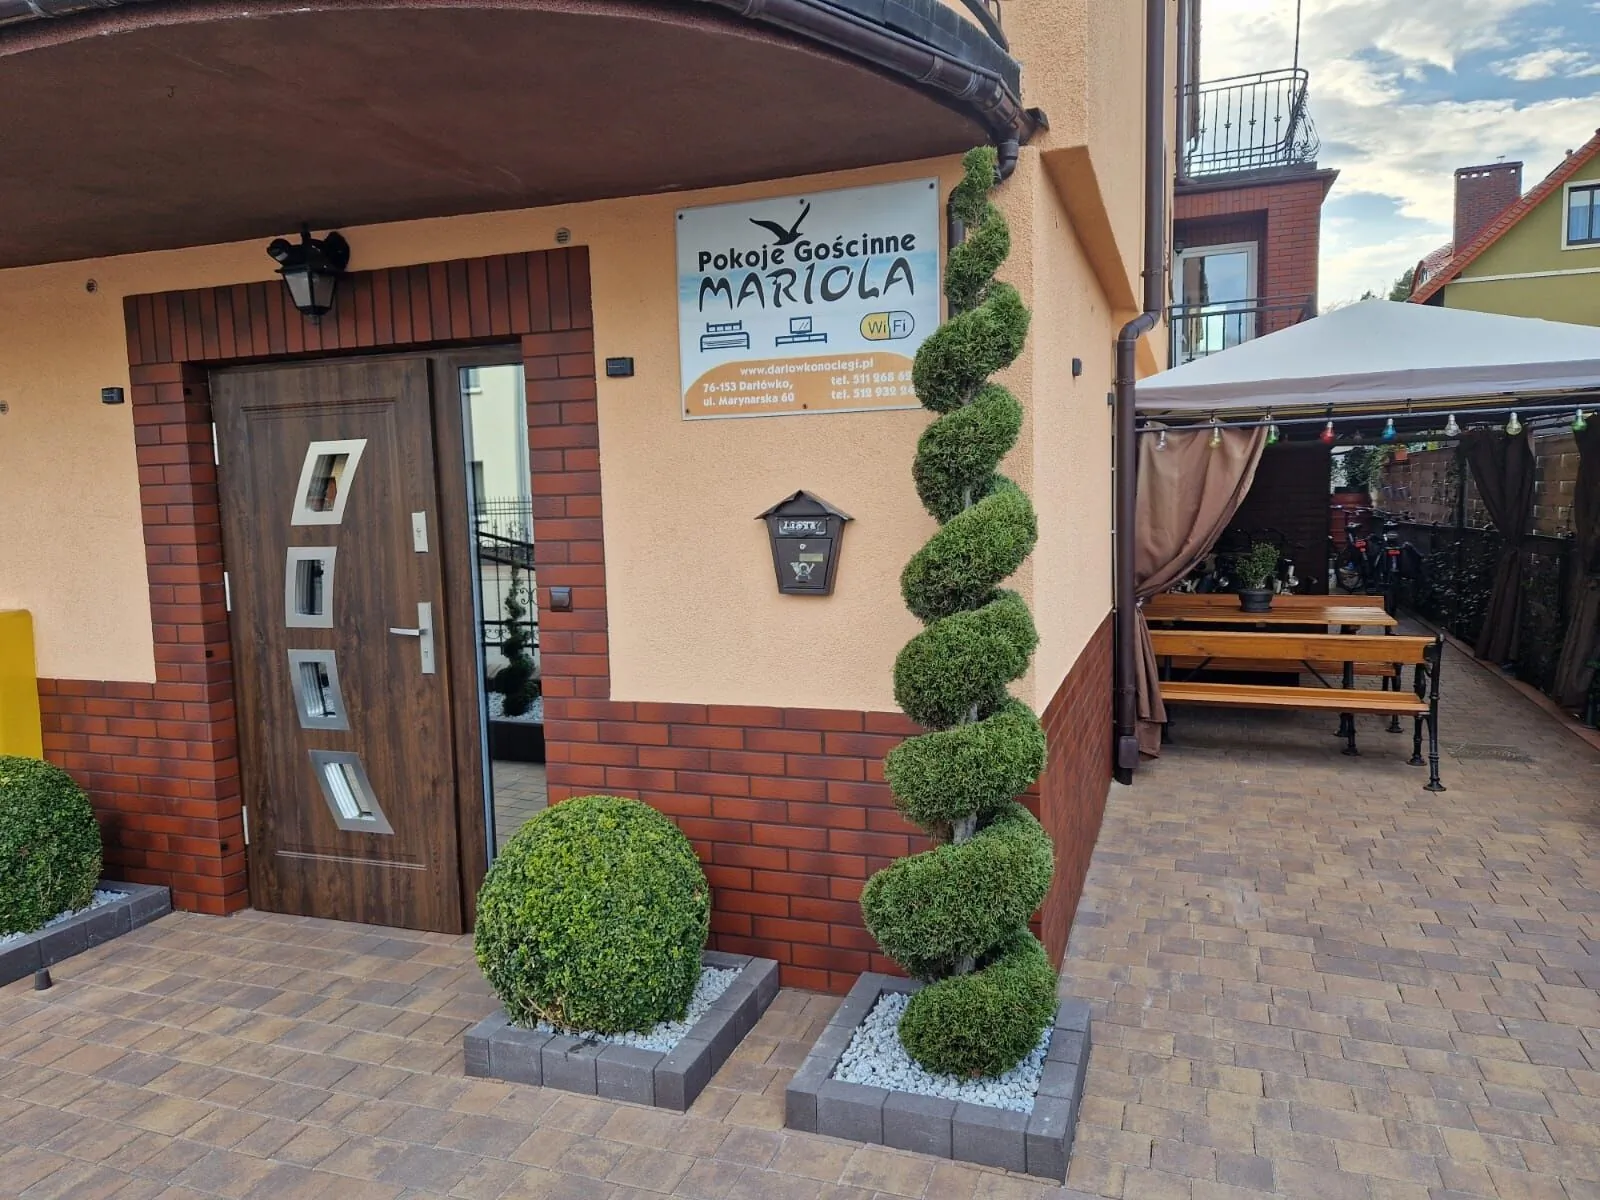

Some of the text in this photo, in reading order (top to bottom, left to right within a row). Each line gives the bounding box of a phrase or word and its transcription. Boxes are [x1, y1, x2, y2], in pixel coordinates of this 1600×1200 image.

[699, 233, 916, 272] Pokoje Gościnne
[699, 257, 914, 312] MARIOLA
[740, 357, 874, 376] www.darlowkonoclegi.pl
[703, 382, 737, 393] 76-153
[831, 375, 850, 386] tel.
[703, 392, 795, 407] ul. Marynarska 60
[831, 389, 850, 400] tel.
